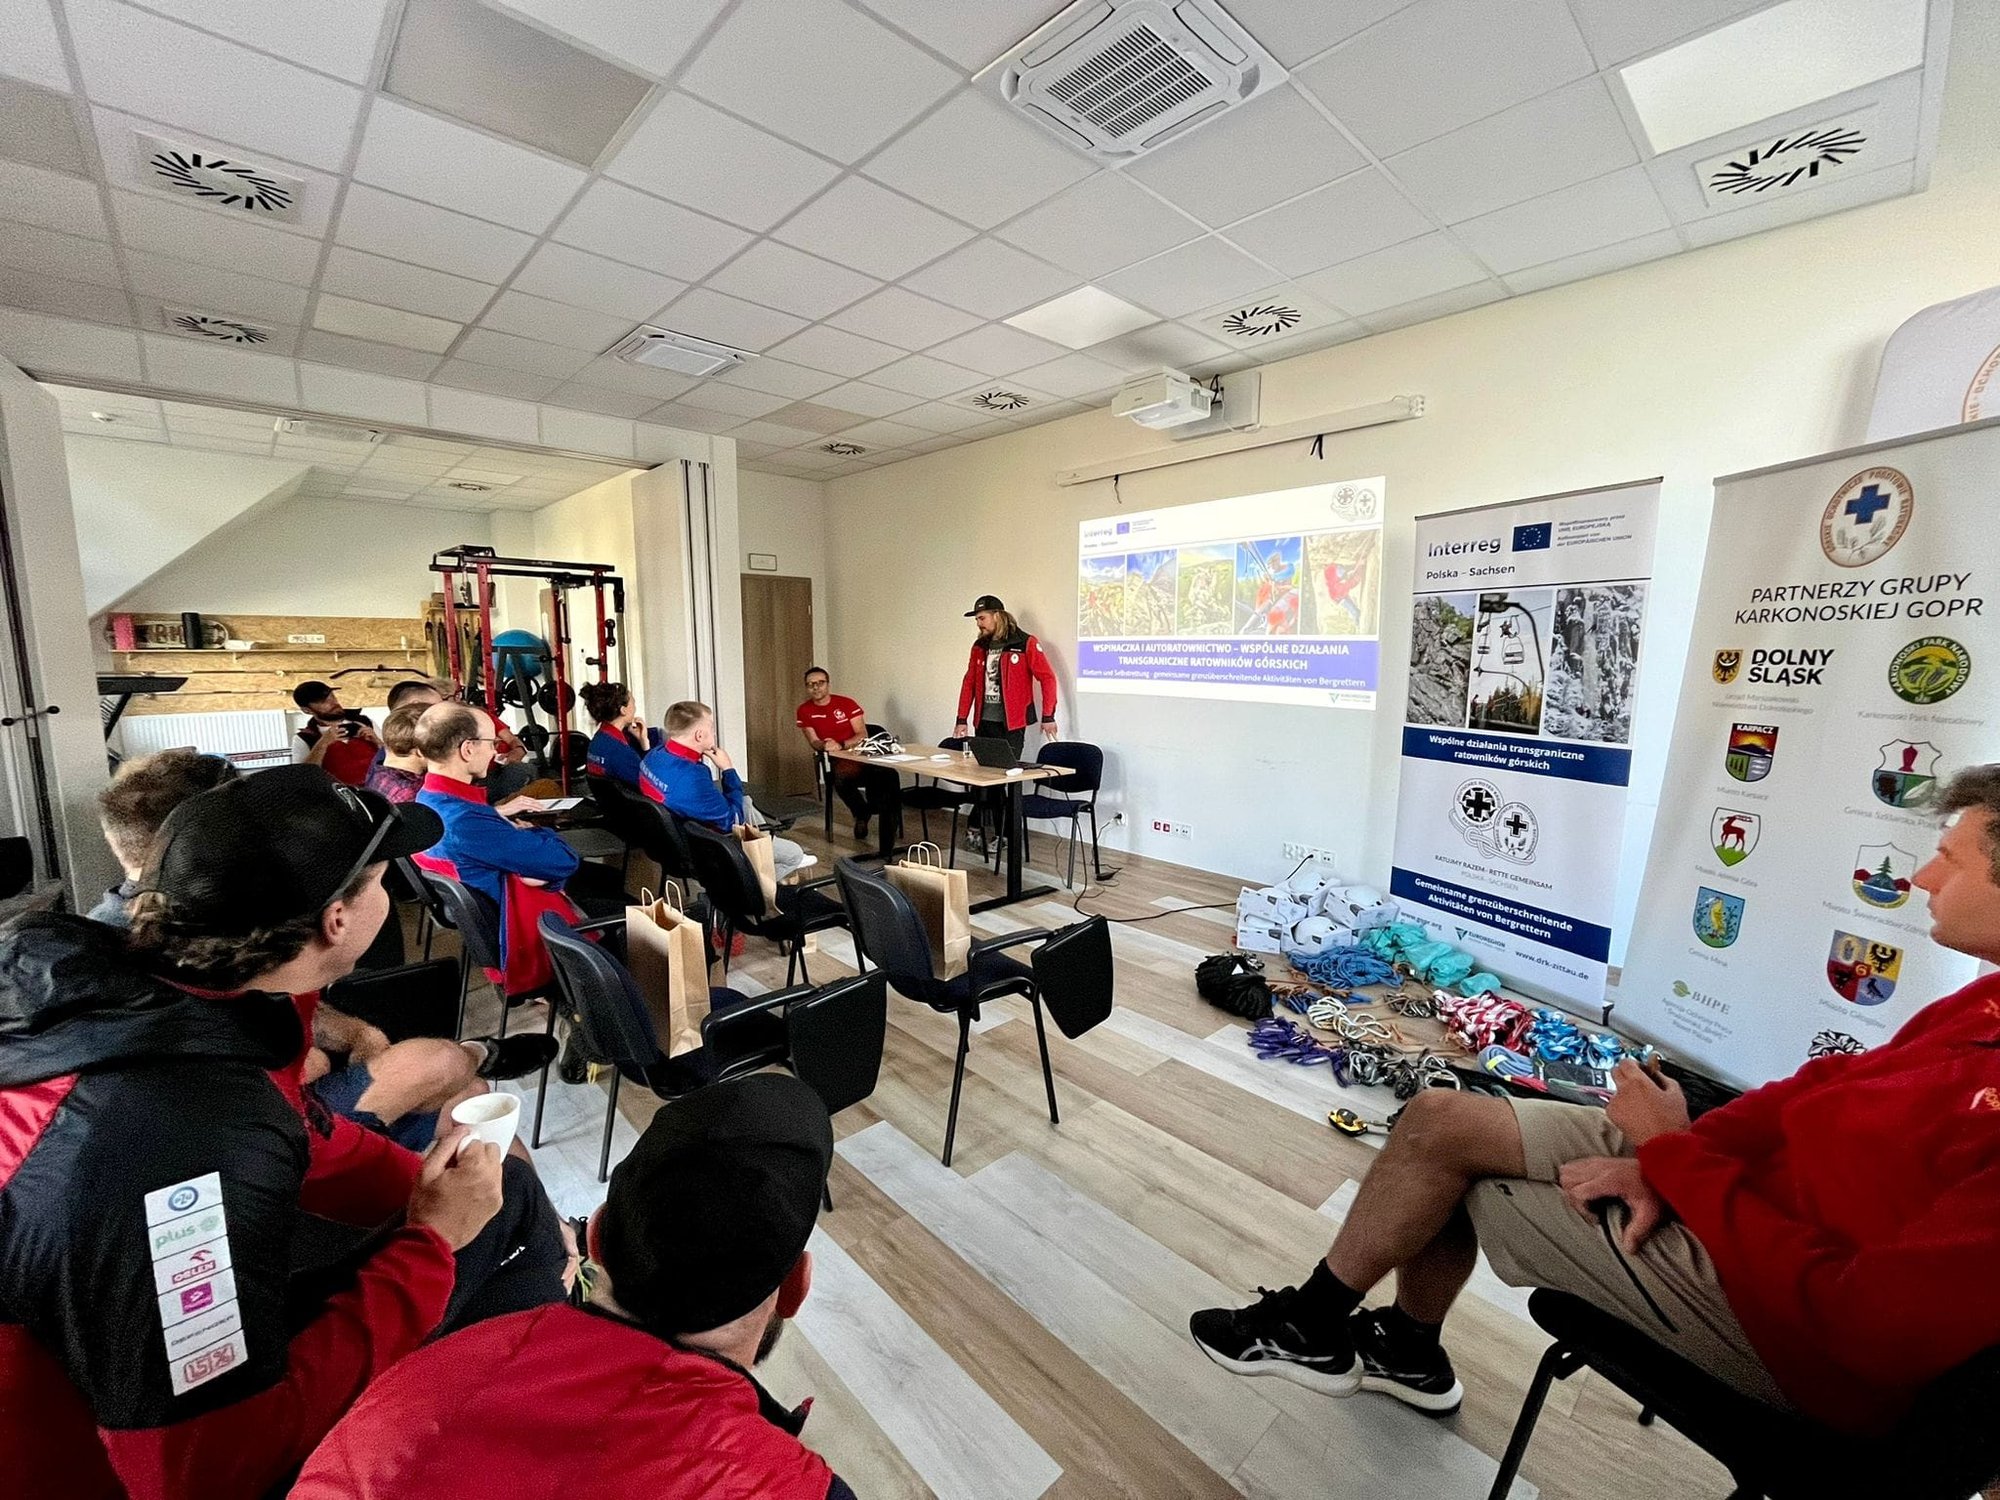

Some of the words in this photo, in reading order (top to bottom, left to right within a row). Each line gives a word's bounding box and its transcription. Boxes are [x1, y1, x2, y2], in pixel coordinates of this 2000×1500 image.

[1428, 538, 1501, 557] Interreg
[1426, 569, 1458, 580] Polska
[1469, 564, 1516, 577] Sachsen
[1751, 579, 1875, 604] PARTNERZY
[1880, 572, 1972, 596] GRUPY
[1735, 602, 1899, 624] KARKONOSKIEJ
[1906, 598, 1984, 618] GOPR
[1092, 643, 1141, 653] WSPINACZKA
[1146, 643, 1232, 654] AUTORATOWNICTWO
[1240, 642, 1289, 655] WSPÓLNE
[1291, 643, 1350, 656] DZIAŁANIA
[1751, 648, 1835, 666] DOLNY
[1118, 656, 1189, 667] TRANSGRANICZNE
[1190, 656, 1253, 669] RATOWNIKÓW
[1254, 656, 1308, 671] GÓRSKICH
[1747, 663, 1824, 687] ŚLĄSK
[1922, 638, 1950, 648] PARK
[1945, 643, 1969, 695] NARODOWY
[1262, 674, 1301, 684] Aktivitäten
[1319, 677, 1366, 688] Bergrettern
[1736, 724, 1774, 735] KARPACZ
[1429, 735, 1465, 747] Wspólne
[1466, 738, 1508, 752] działania
[1509, 744, 1585, 761] transgraniczne
[1454, 751, 1507, 765] ratowników
[1508, 757, 1550, 770] górskich
[1462, 862, 1485, 872] RAZEM
[1489, 868, 1509, 879] RETTE
[1510, 874, 1553, 890] GEMEINSAM
[1414, 877, 1467, 900] Gemeinsame
[1468, 894, 1573, 932] grenzüberschreitende
[1428, 893, 1475, 914] Aktivitäten
[1476, 909, 1493, 920] von
[1495, 912, 1551, 939] Bergrettern
[1468, 931, 1506, 948] EUROREGION
[1515, 950, 1589, 981] www.drk-zittau.de
[155, 1225, 195, 1249] plus
[173, 1261, 215, 1283] ORLEN
